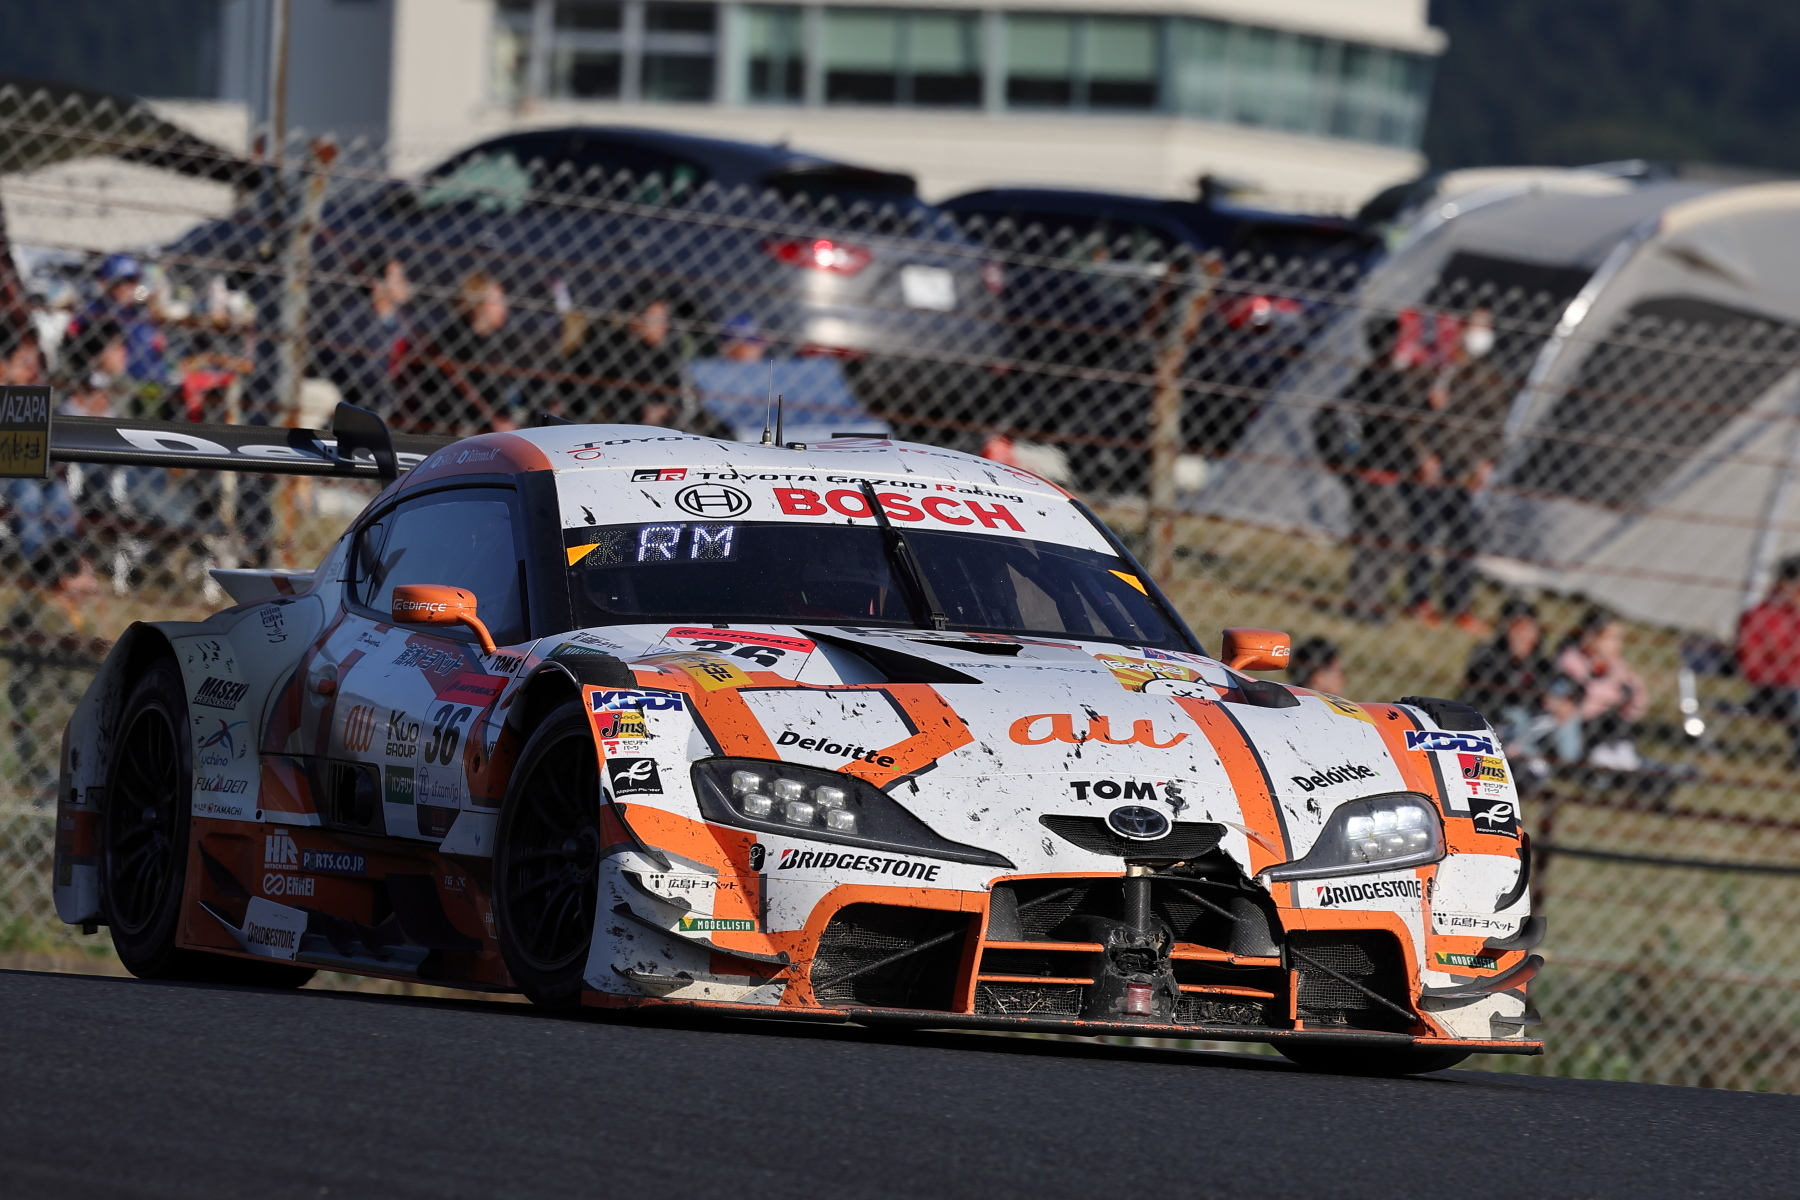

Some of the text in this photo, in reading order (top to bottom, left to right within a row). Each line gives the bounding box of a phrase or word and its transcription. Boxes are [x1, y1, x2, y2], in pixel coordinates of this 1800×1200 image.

[632, 468, 1024, 503] GR TOYOTA GAZOO Racing
[773, 487, 1026, 532] BOSCH
[700, 632, 809, 648] AUTOBACS
[489, 655, 523, 673] TOM'S
[197, 676, 250, 702] MASEKI
[456, 683, 501, 697] AUTOBACS
[194, 695, 237, 708] GEINOSHA
[592, 691, 683, 711] KDDI
[343, 705, 377, 753] au
[425, 704, 472, 766] 36
[1008, 713, 1190, 749] au
[386, 743, 417, 759] GROUP
[1405, 731, 1494, 755] KDDI
[201, 752, 228, 766] uchino
[1070, 780, 1184, 812] TOM'S
[213, 804, 243, 816] TAMACHI
[1497, 829, 1518, 838] Pioneer
[778, 849, 941, 882] BRIDGESTONE
[668, 879, 738, 890] 広島トヨペット
[1317, 880, 1422, 907] BRIDGESTONE
[697, 919, 751, 930] MODELLISTA
[1451, 917, 1515, 931] 広島トヨペット
[247, 922, 296, 949] BRIDGESTONE
[1451, 955, 1495, 969] MODELLISTA
